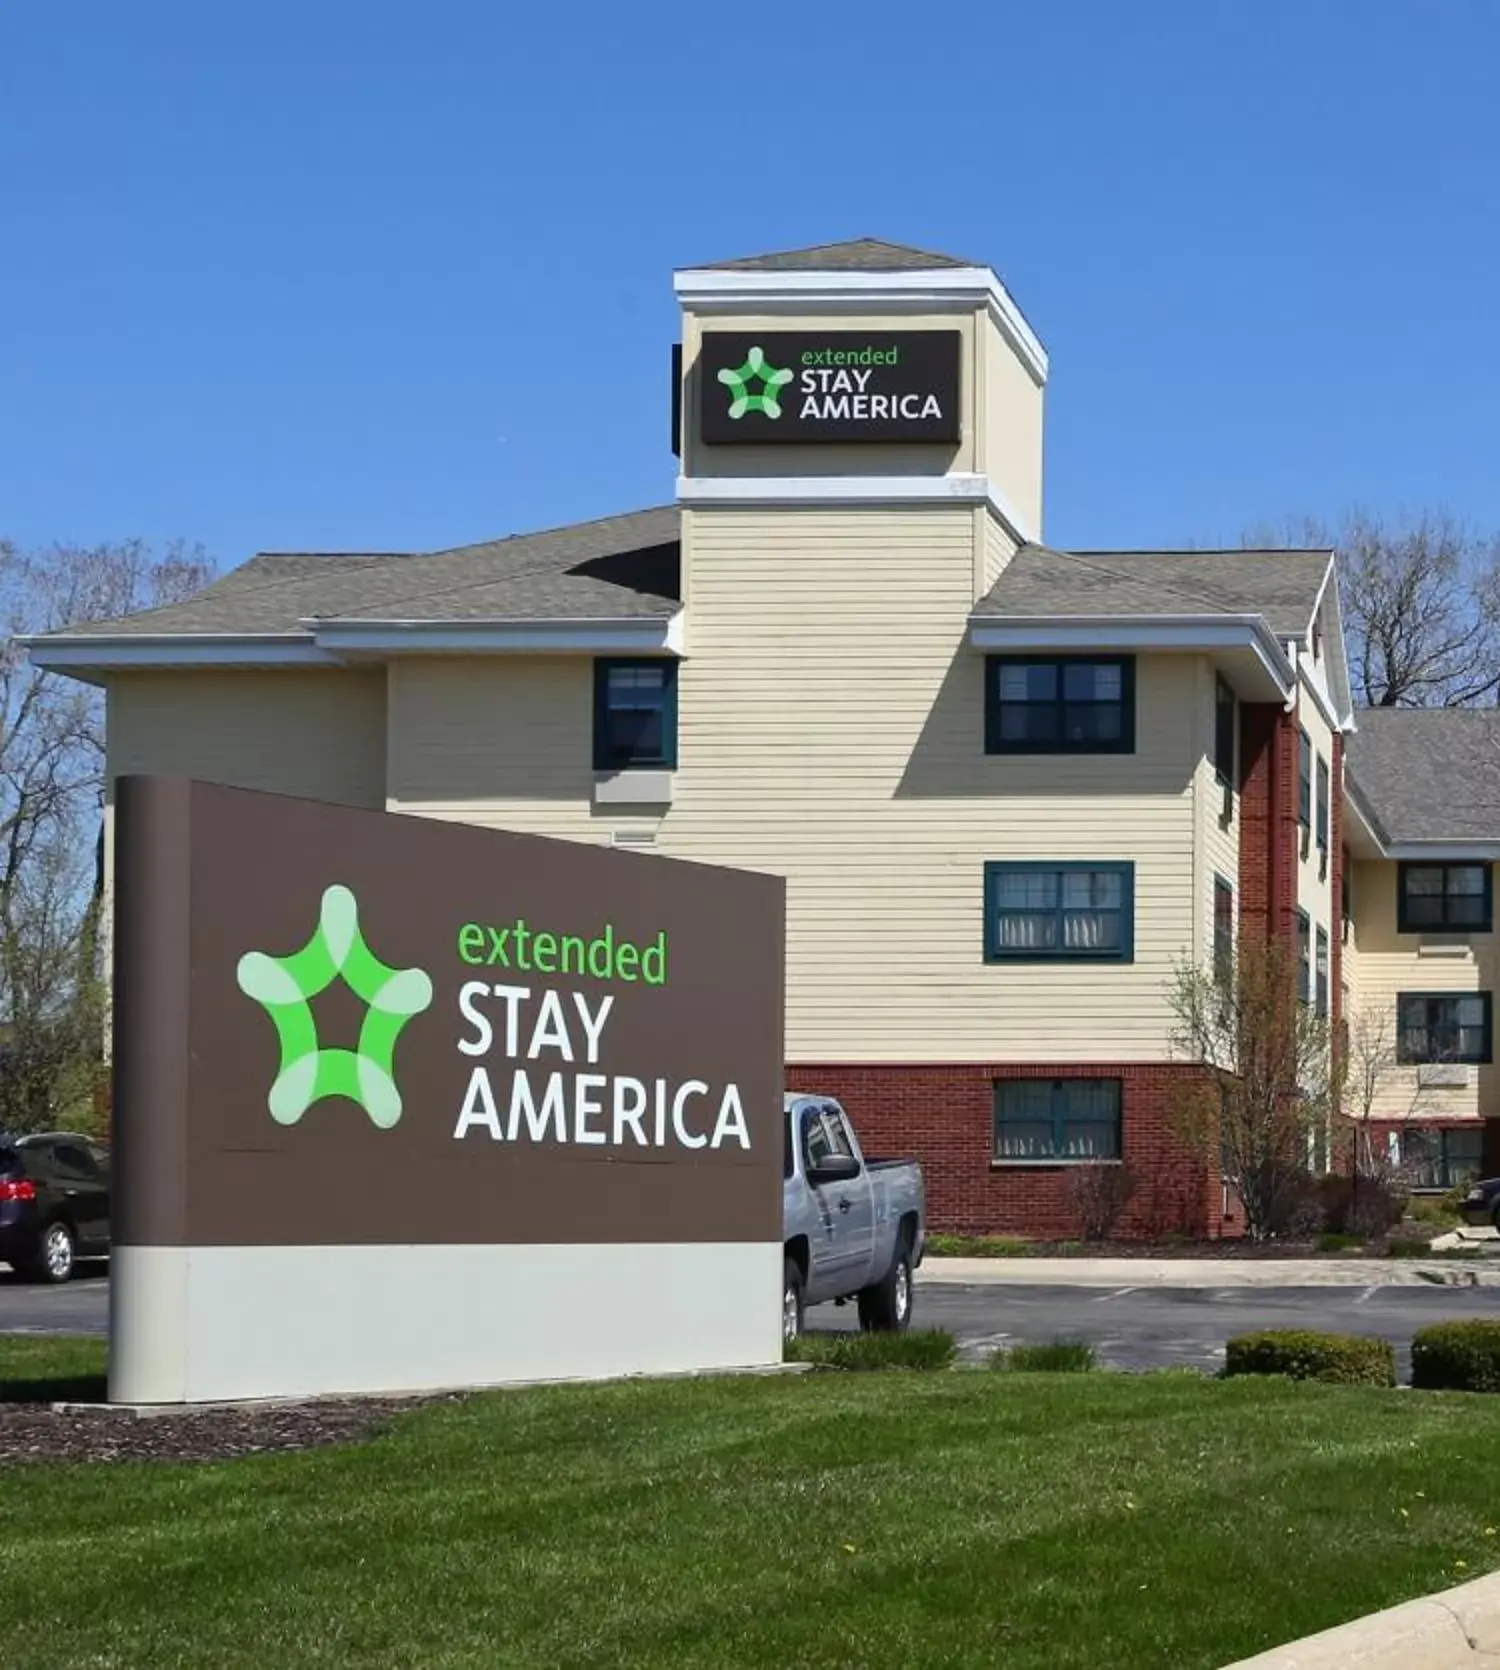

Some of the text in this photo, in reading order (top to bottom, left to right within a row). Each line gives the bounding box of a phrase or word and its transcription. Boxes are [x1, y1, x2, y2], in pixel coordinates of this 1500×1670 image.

[800, 345, 897, 365] extended
[800, 368, 873, 394] STAY
[799, 394, 943, 420] AMERICA
[457, 919, 668, 985] extended
[456, 980, 615, 1064] STAY
[452, 1066, 752, 1150] AMERICA
